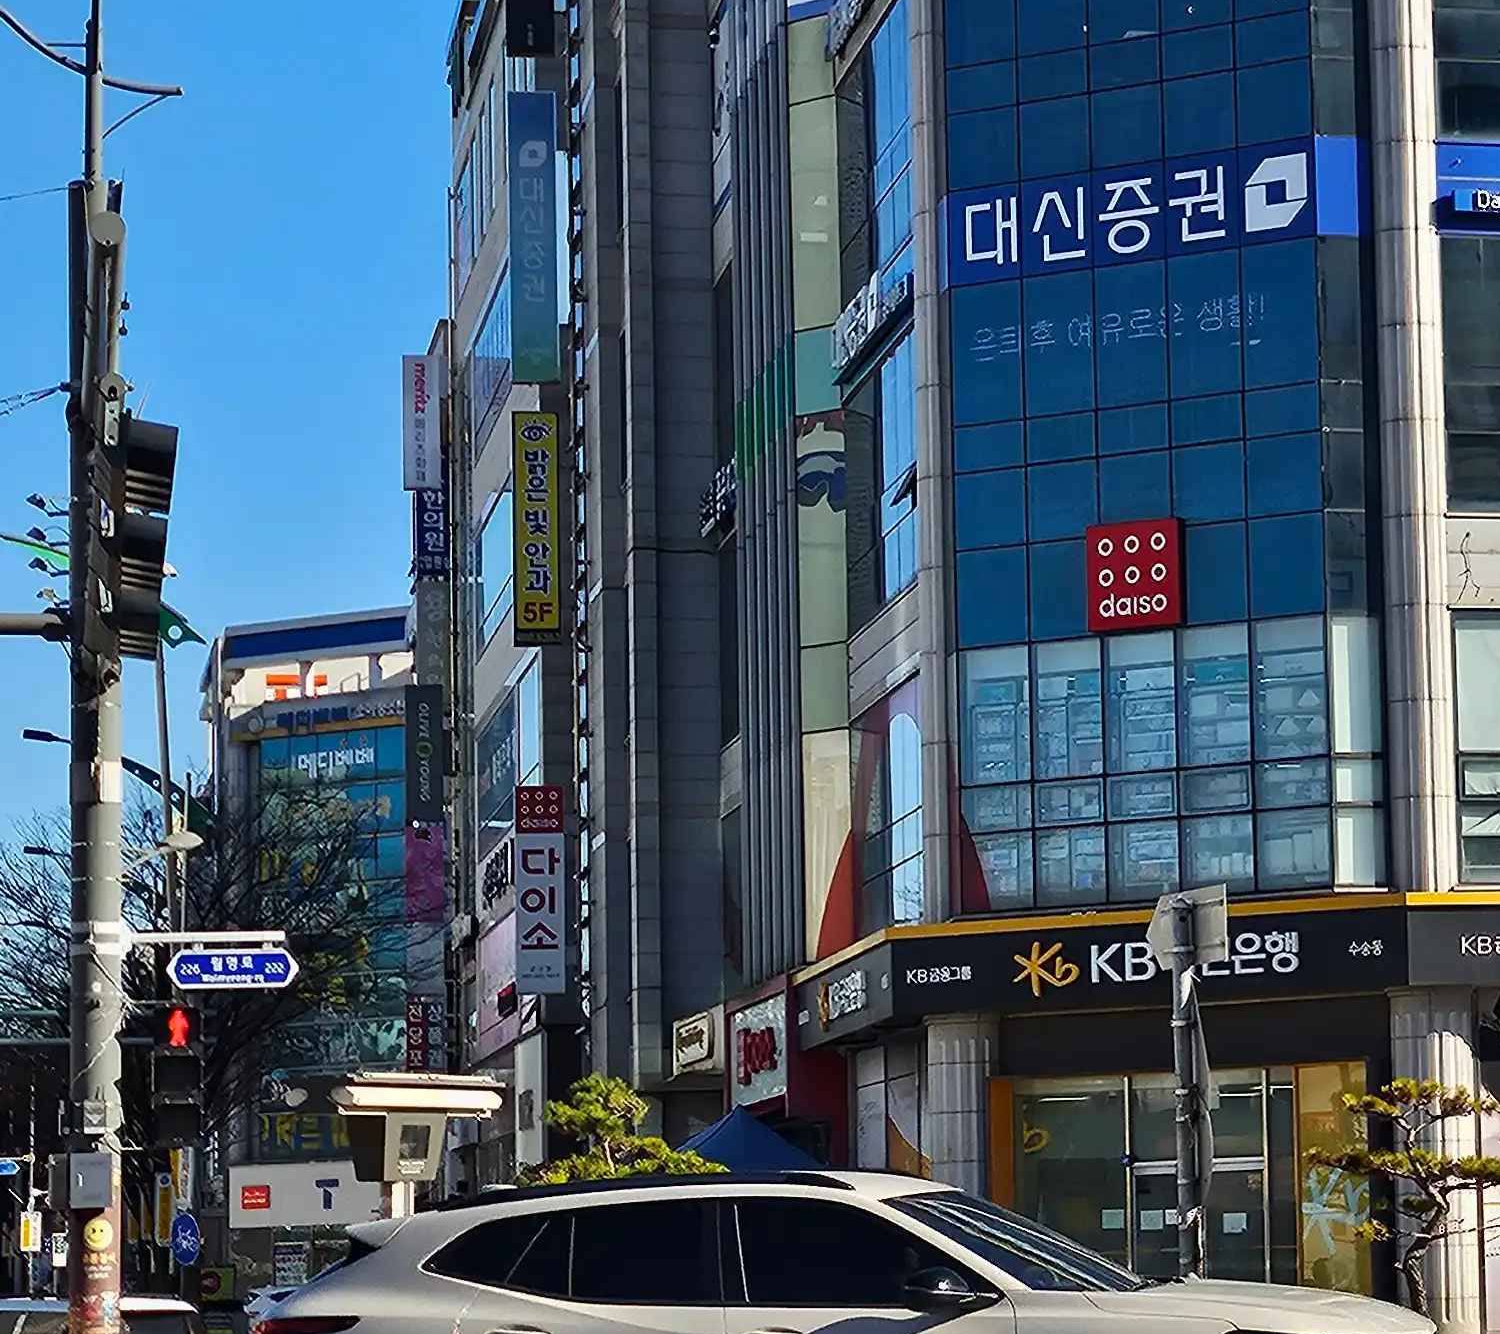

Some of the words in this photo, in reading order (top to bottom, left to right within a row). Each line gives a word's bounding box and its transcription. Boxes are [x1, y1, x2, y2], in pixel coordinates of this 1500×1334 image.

[965, 166, 1229, 267] 대신증권
[522, 602, 553, 624] 5F
[1098, 592, 1168, 618] daiso
[520, 846, 561, 951] 다이소
[1089, 930, 1301, 984] KB은행
